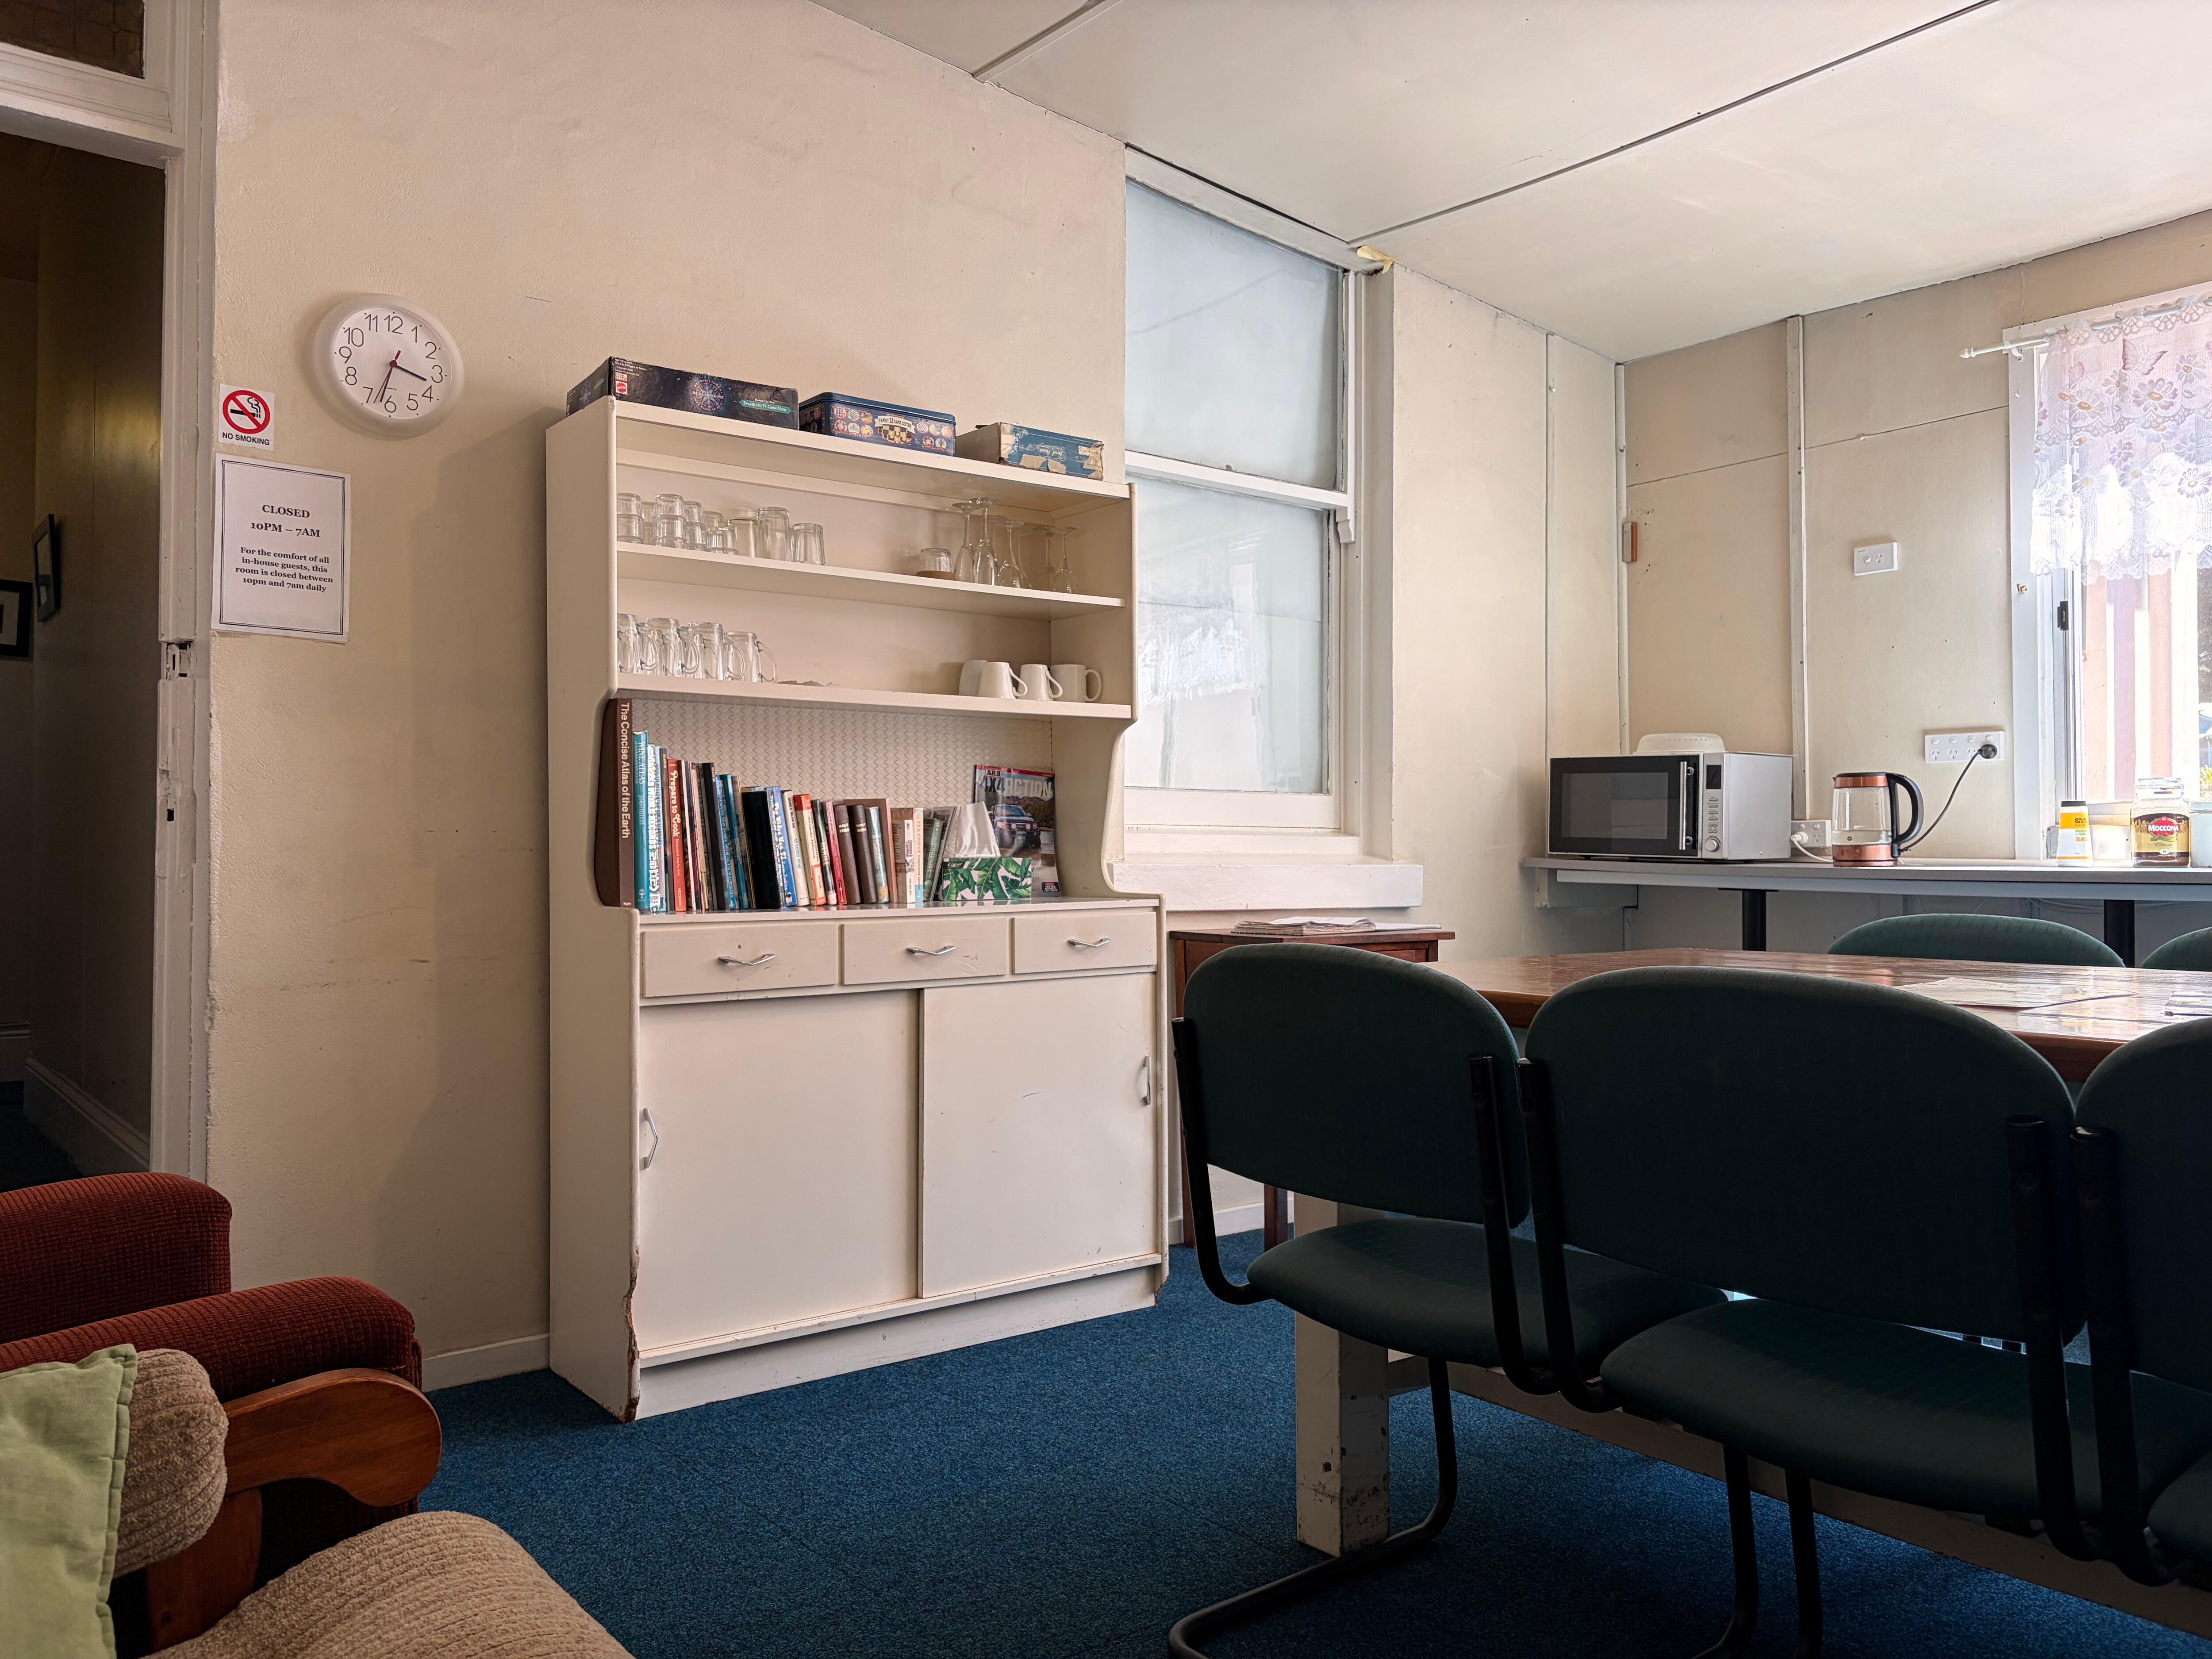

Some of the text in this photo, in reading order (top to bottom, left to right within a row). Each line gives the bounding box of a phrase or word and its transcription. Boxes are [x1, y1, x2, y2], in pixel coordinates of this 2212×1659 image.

[365, 314, 378, 332] 11
[384, 315, 403, 334] 12
[344, 327, 364, 347] 10
[411, 326, 418, 343] 1
[339, 346, 352, 364] 9
[425, 342, 437, 360] 2
[345, 366, 357, 386] 8
[431, 365, 443, 383] 3
[363, 386, 373, 403] 7
[407, 393, 419, 411] 5
[422, 384, 434, 402] 4
[384, 395, 397, 413] 6
[235, 434, 270, 445] SMOKING
[262, 504, 310, 518] CLOSED
[250, 522, 283, 533] 10PM
[296, 528, 321, 538] 7AM
[242, 557, 280, 568] in-house
[281, 562, 310, 572] guests,
[273, 553, 307, 561] comfort
[270, 570, 297, 579] closed
[299, 573, 333, 583] between
[306, 584, 326, 593] daily
[621, 702, 631, 838] The Concise Atlas of the Earth
[1004, 777, 1052, 797] ACTION
[669, 770, 681, 837] Prepare to Cook
[648, 815, 657, 849] RECORDS
[774, 832, 779, 842] OF
[2148, 824, 2179, 832] MOCCONA
